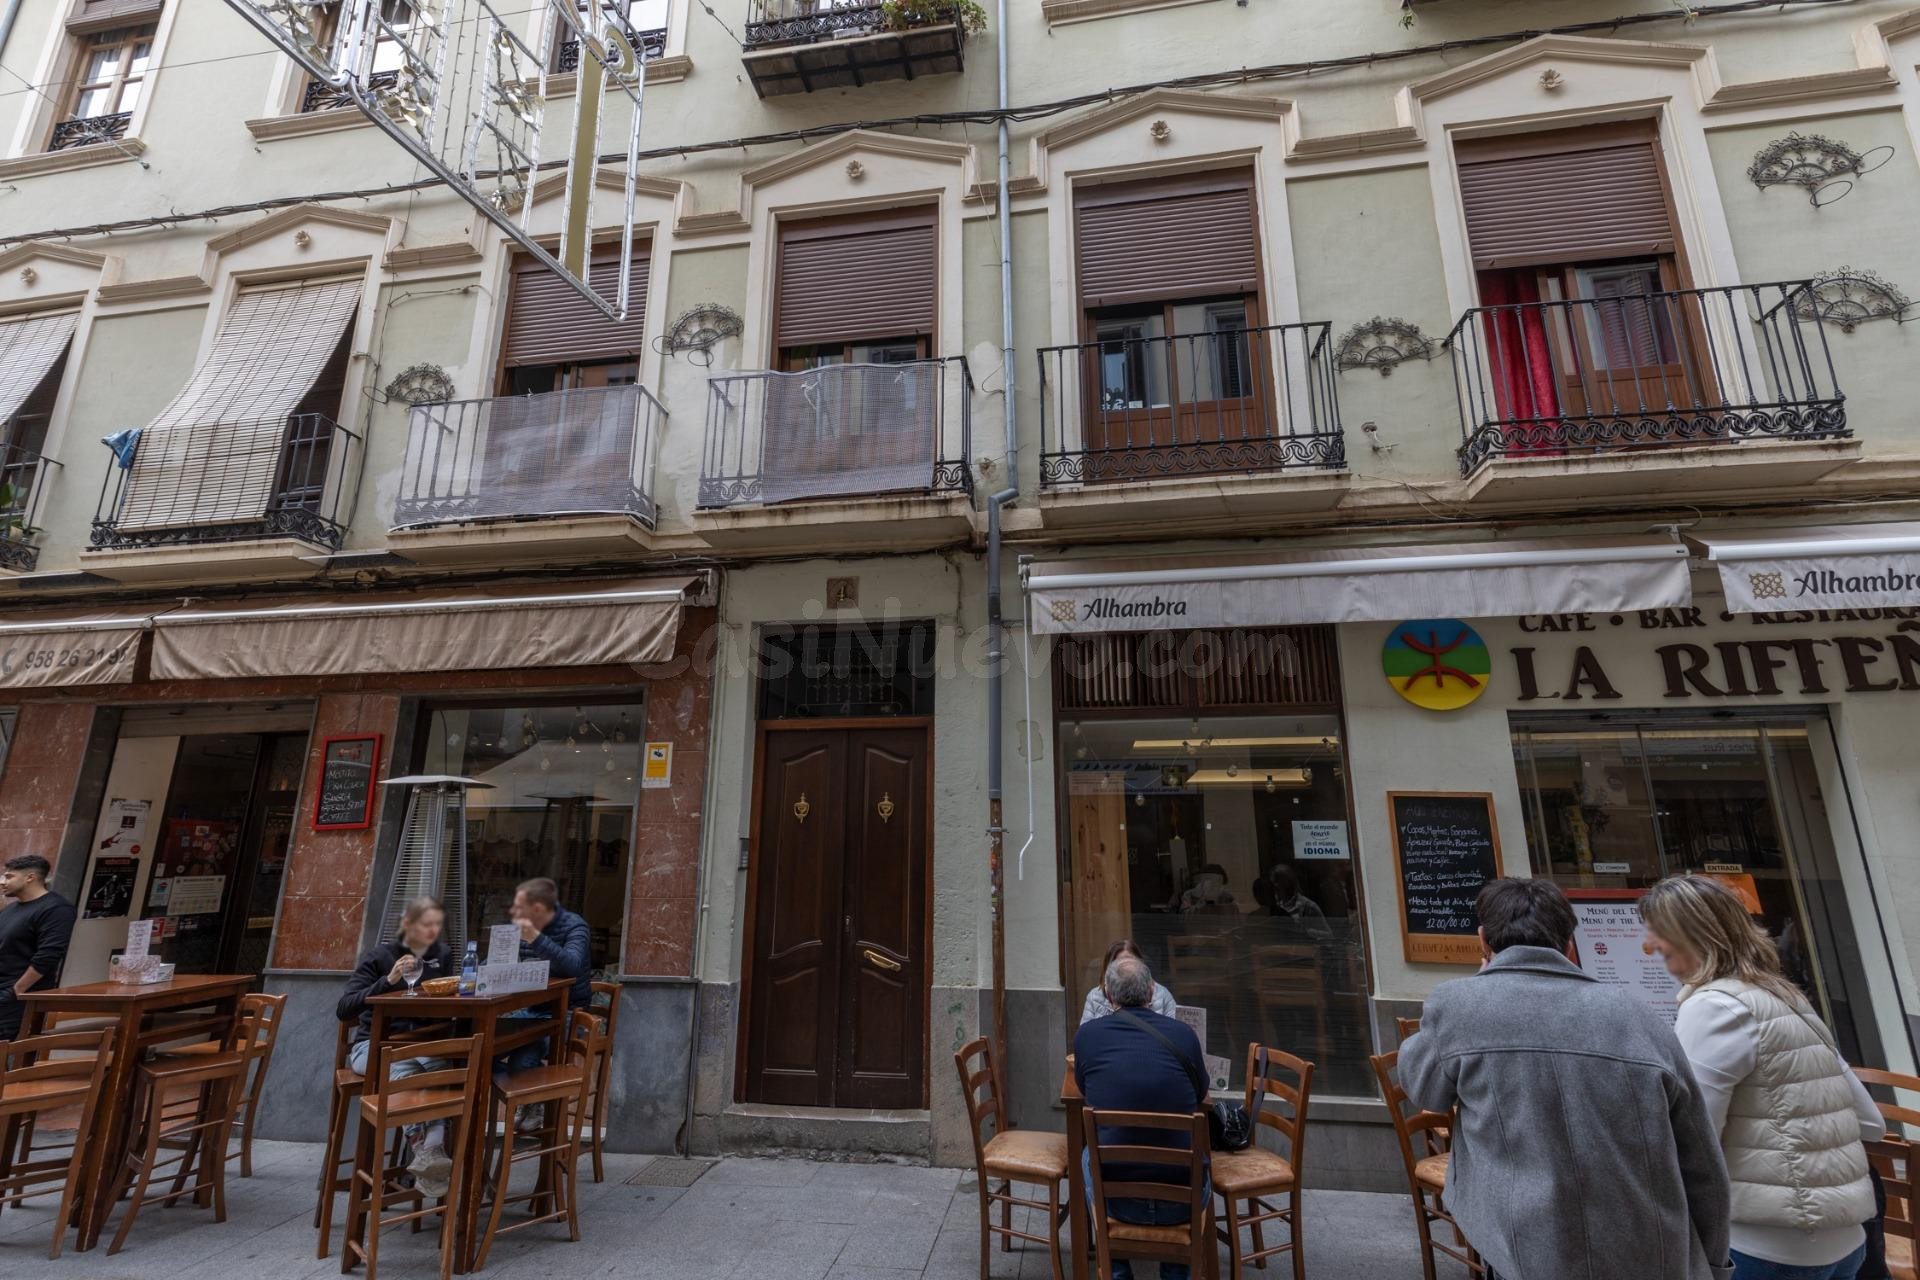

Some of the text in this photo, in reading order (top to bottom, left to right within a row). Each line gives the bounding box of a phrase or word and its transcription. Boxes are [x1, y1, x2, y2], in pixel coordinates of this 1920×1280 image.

[836, 583, 847, 600] 4
[1083, 596, 1187, 621] Alhambra
[1640, 606, 1707, 629] BAR
[25, 650, 55, 669] 958
[57, 649, 80, 667] 26
[84, 648, 105, 667] 21
[1509, 646, 1623, 700] LA
[1411, 943, 1455, 953] CERVEZAS
